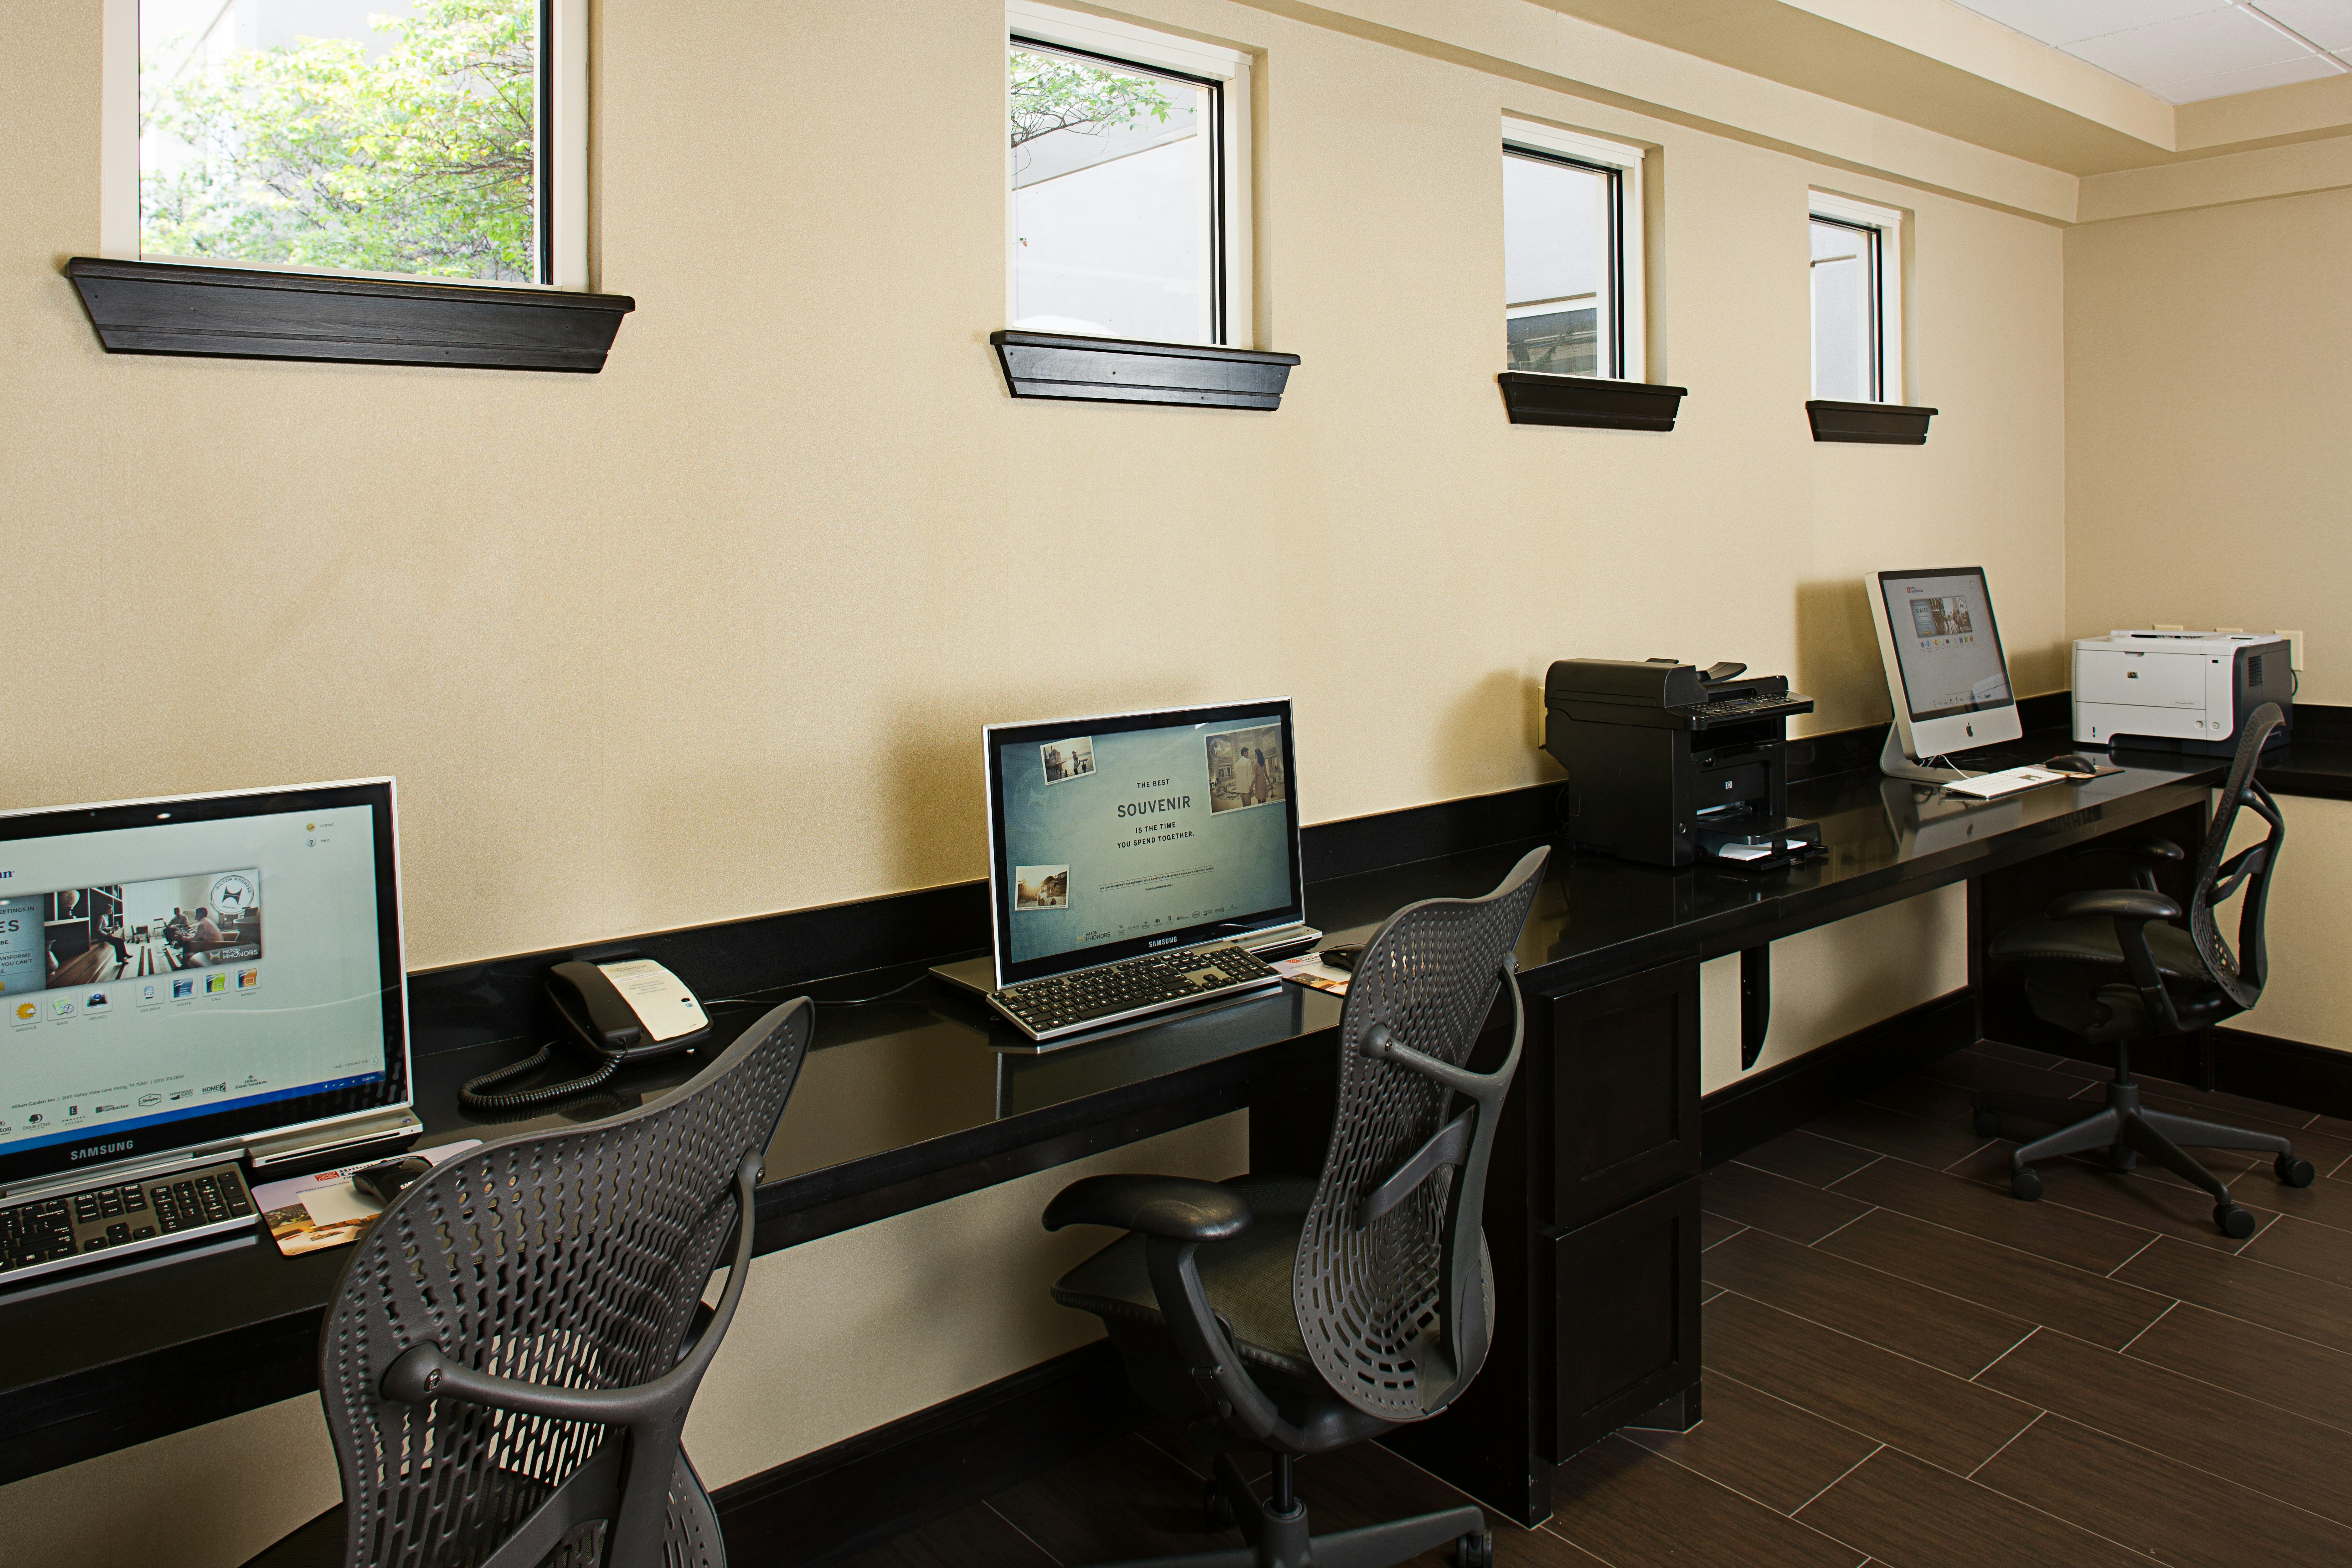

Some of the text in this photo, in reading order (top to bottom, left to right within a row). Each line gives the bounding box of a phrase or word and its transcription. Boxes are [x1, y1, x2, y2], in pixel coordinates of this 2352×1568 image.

[1117, 796, 1190, 818] SOUVENIR
[1134, 837, 1155, 846] SPEND
[1158, 831, 1194, 841] TOGETHER.
[216, 878, 251, 893] HILTON HHONORS
[0, 920, 19, 933] ES
[1086, 932, 1110, 941] HHONORS
[1149, 936, 1177, 947] SAMSUNG
[223, 949, 258, 959] HHONORS
[70, 1140, 134, 1160] SAMSUNG
